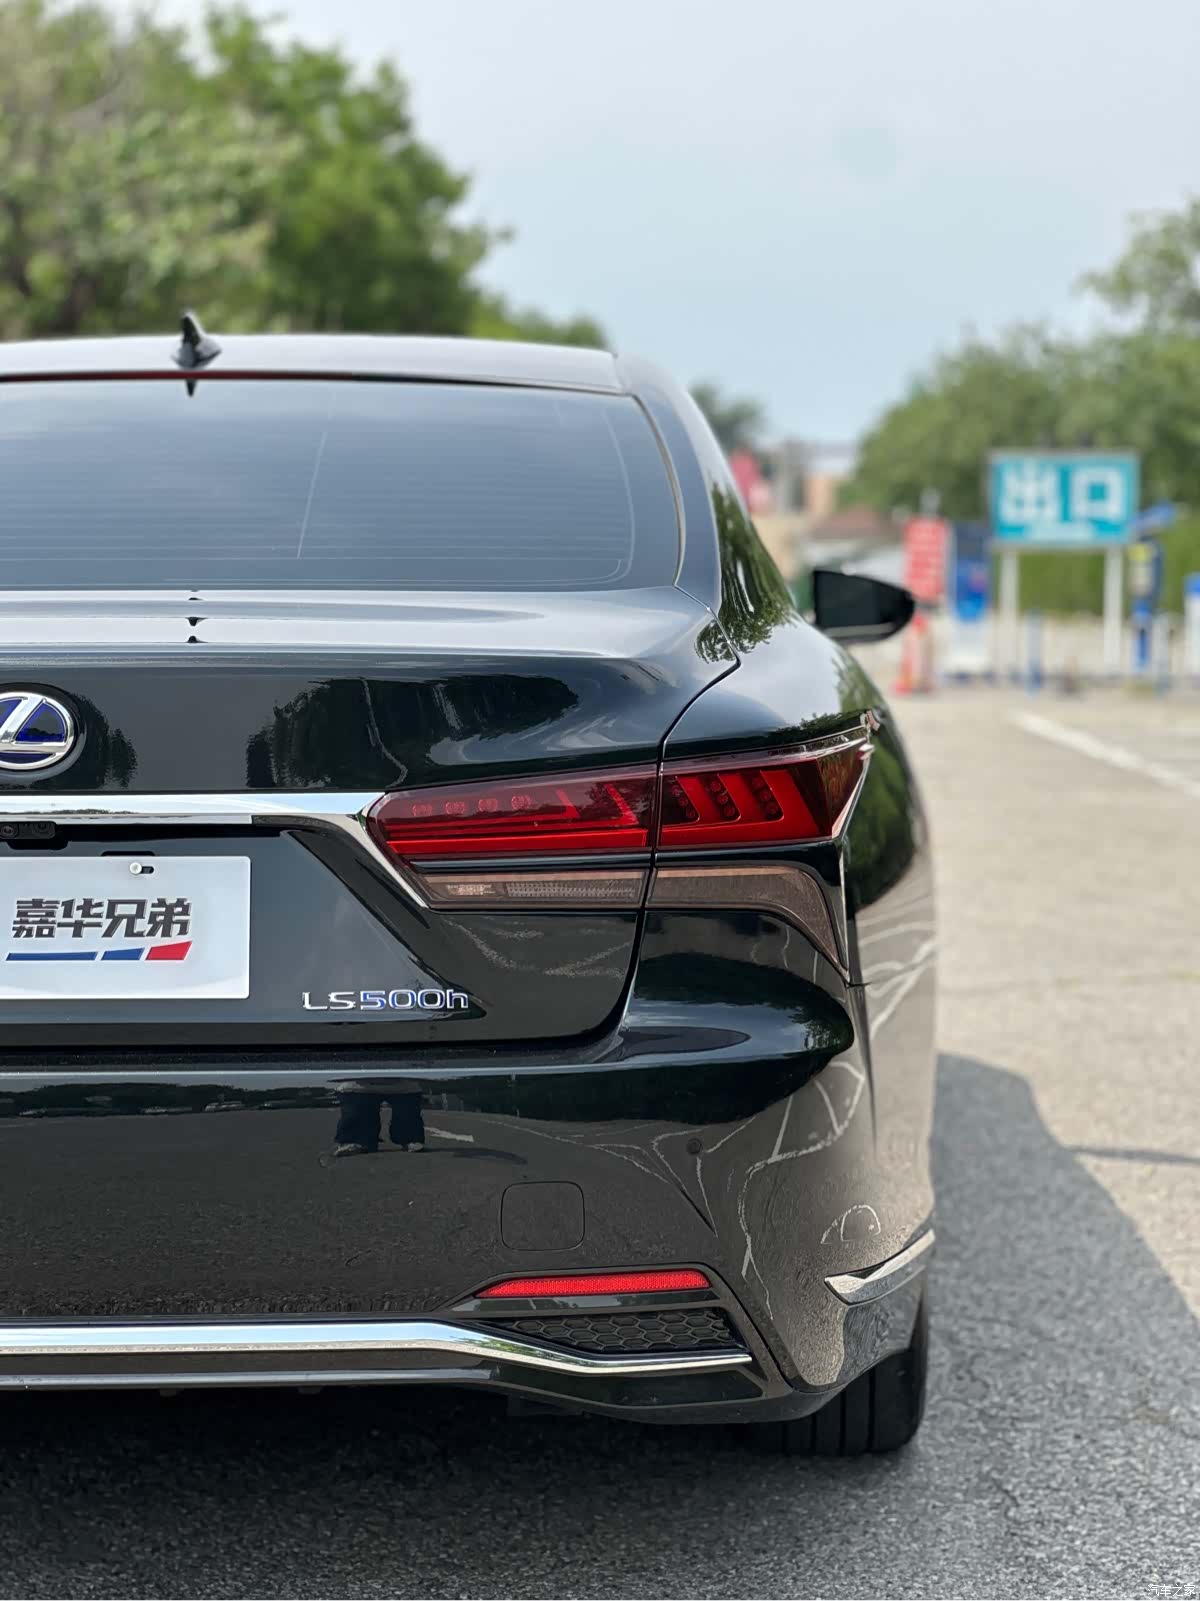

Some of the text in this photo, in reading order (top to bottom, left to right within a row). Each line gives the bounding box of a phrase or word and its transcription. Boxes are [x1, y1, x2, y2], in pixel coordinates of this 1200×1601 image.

[1000, 460, 1127, 525] 出口
[12, 898, 192, 938] 嘉华兄弟
[302, 989, 469, 1010] LS500h
